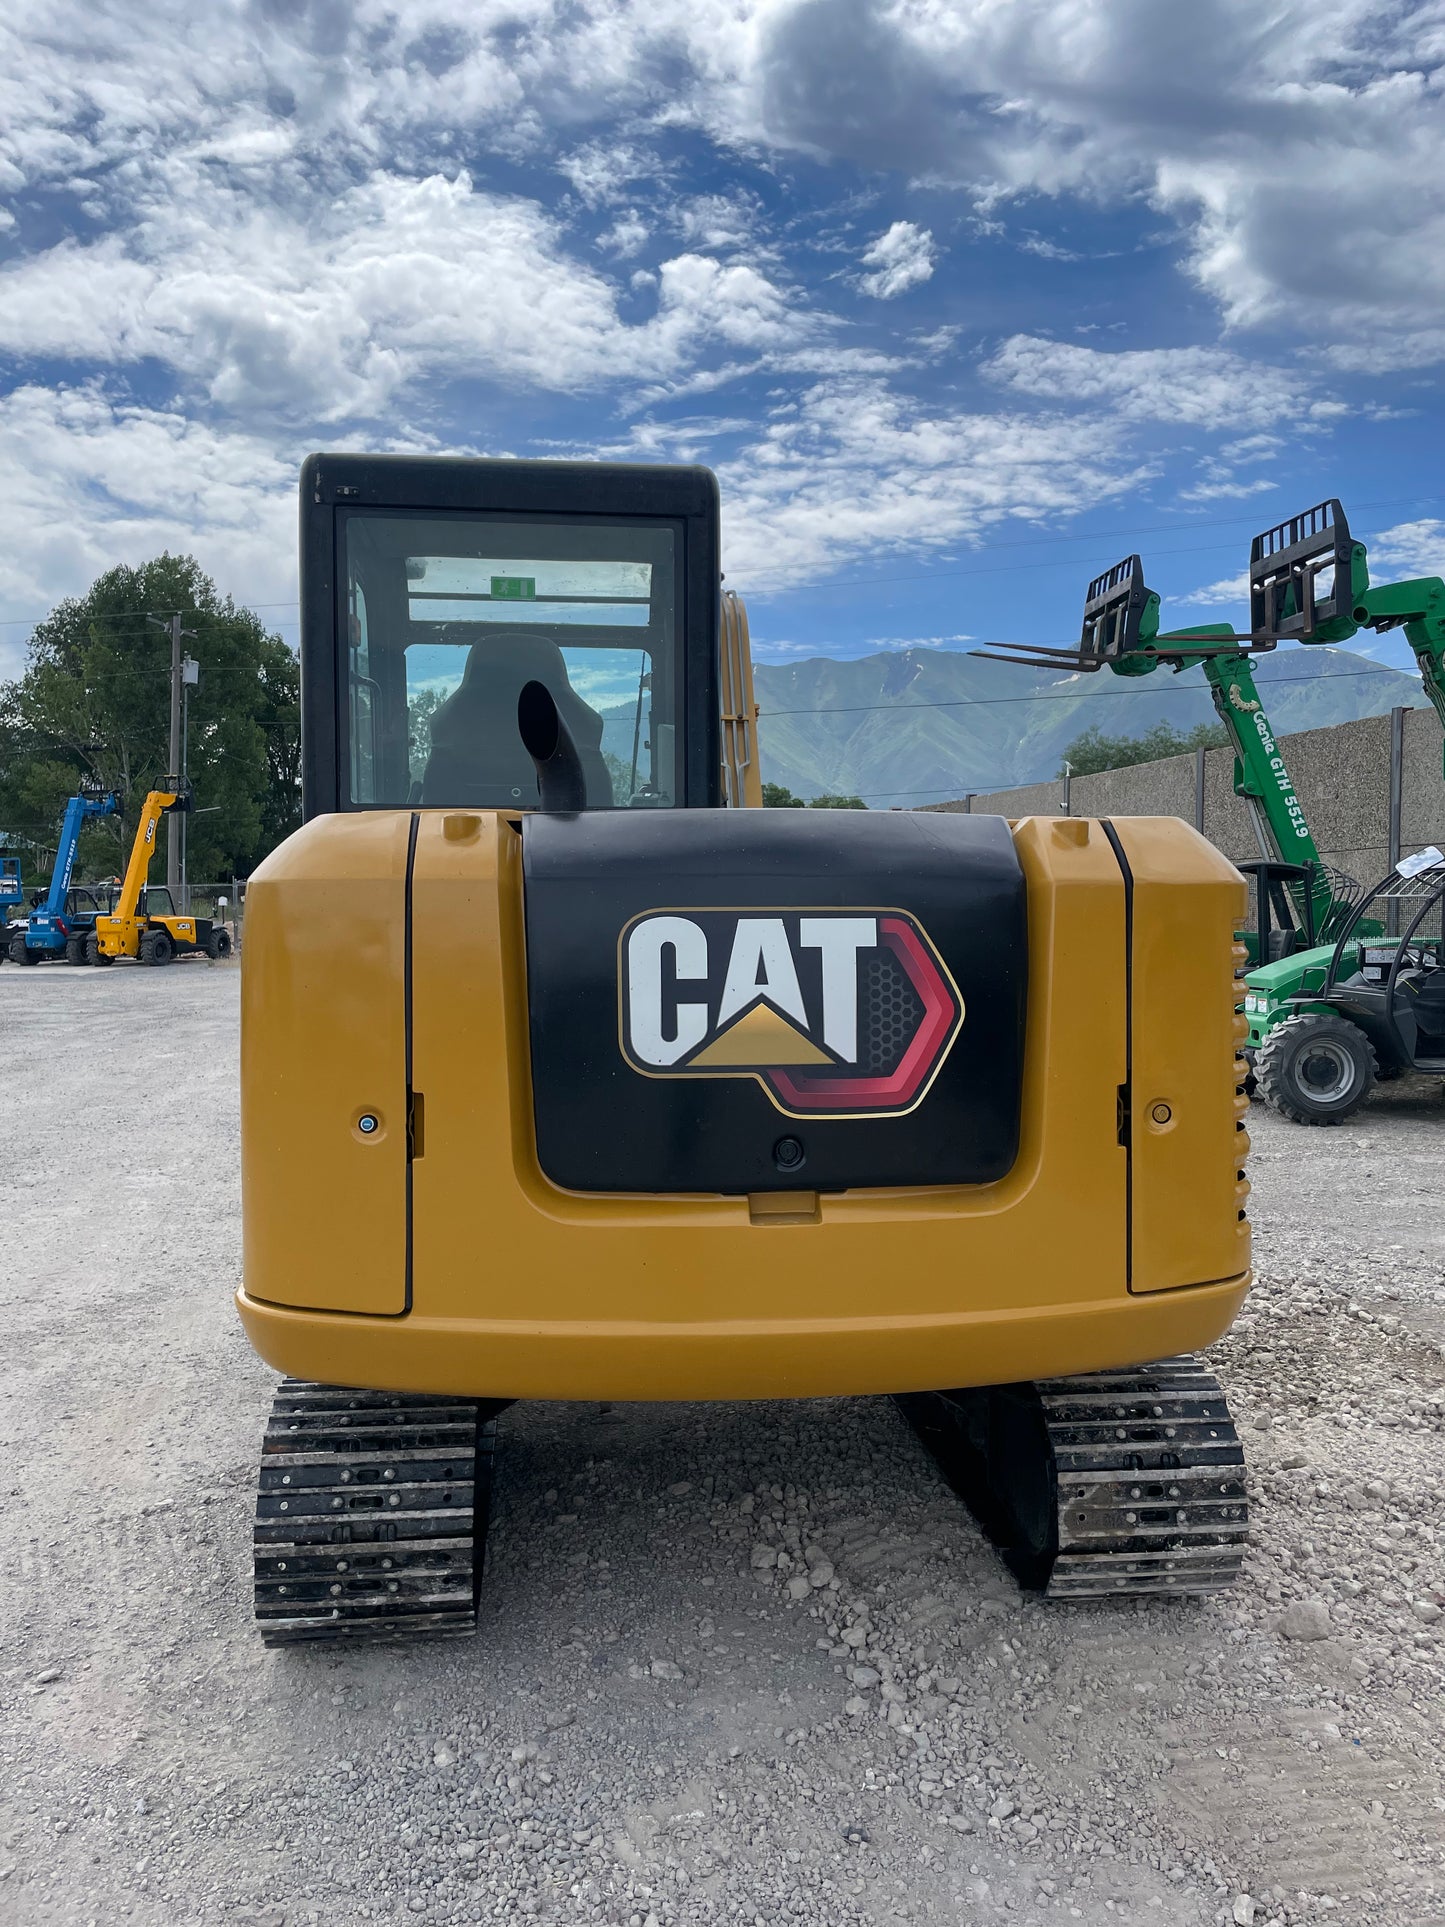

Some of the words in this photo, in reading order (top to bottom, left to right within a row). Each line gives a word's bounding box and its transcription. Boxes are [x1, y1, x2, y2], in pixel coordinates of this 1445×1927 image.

[1253, 710, 1275, 755] Genie
[1270, 757, 1293, 791] GTH
[1284, 795, 1309, 838] 5519
[145, 818, 155, 844] JCB
[176, 922, 191, 930] JCB
[628, 916, 877, 1066] CAT
